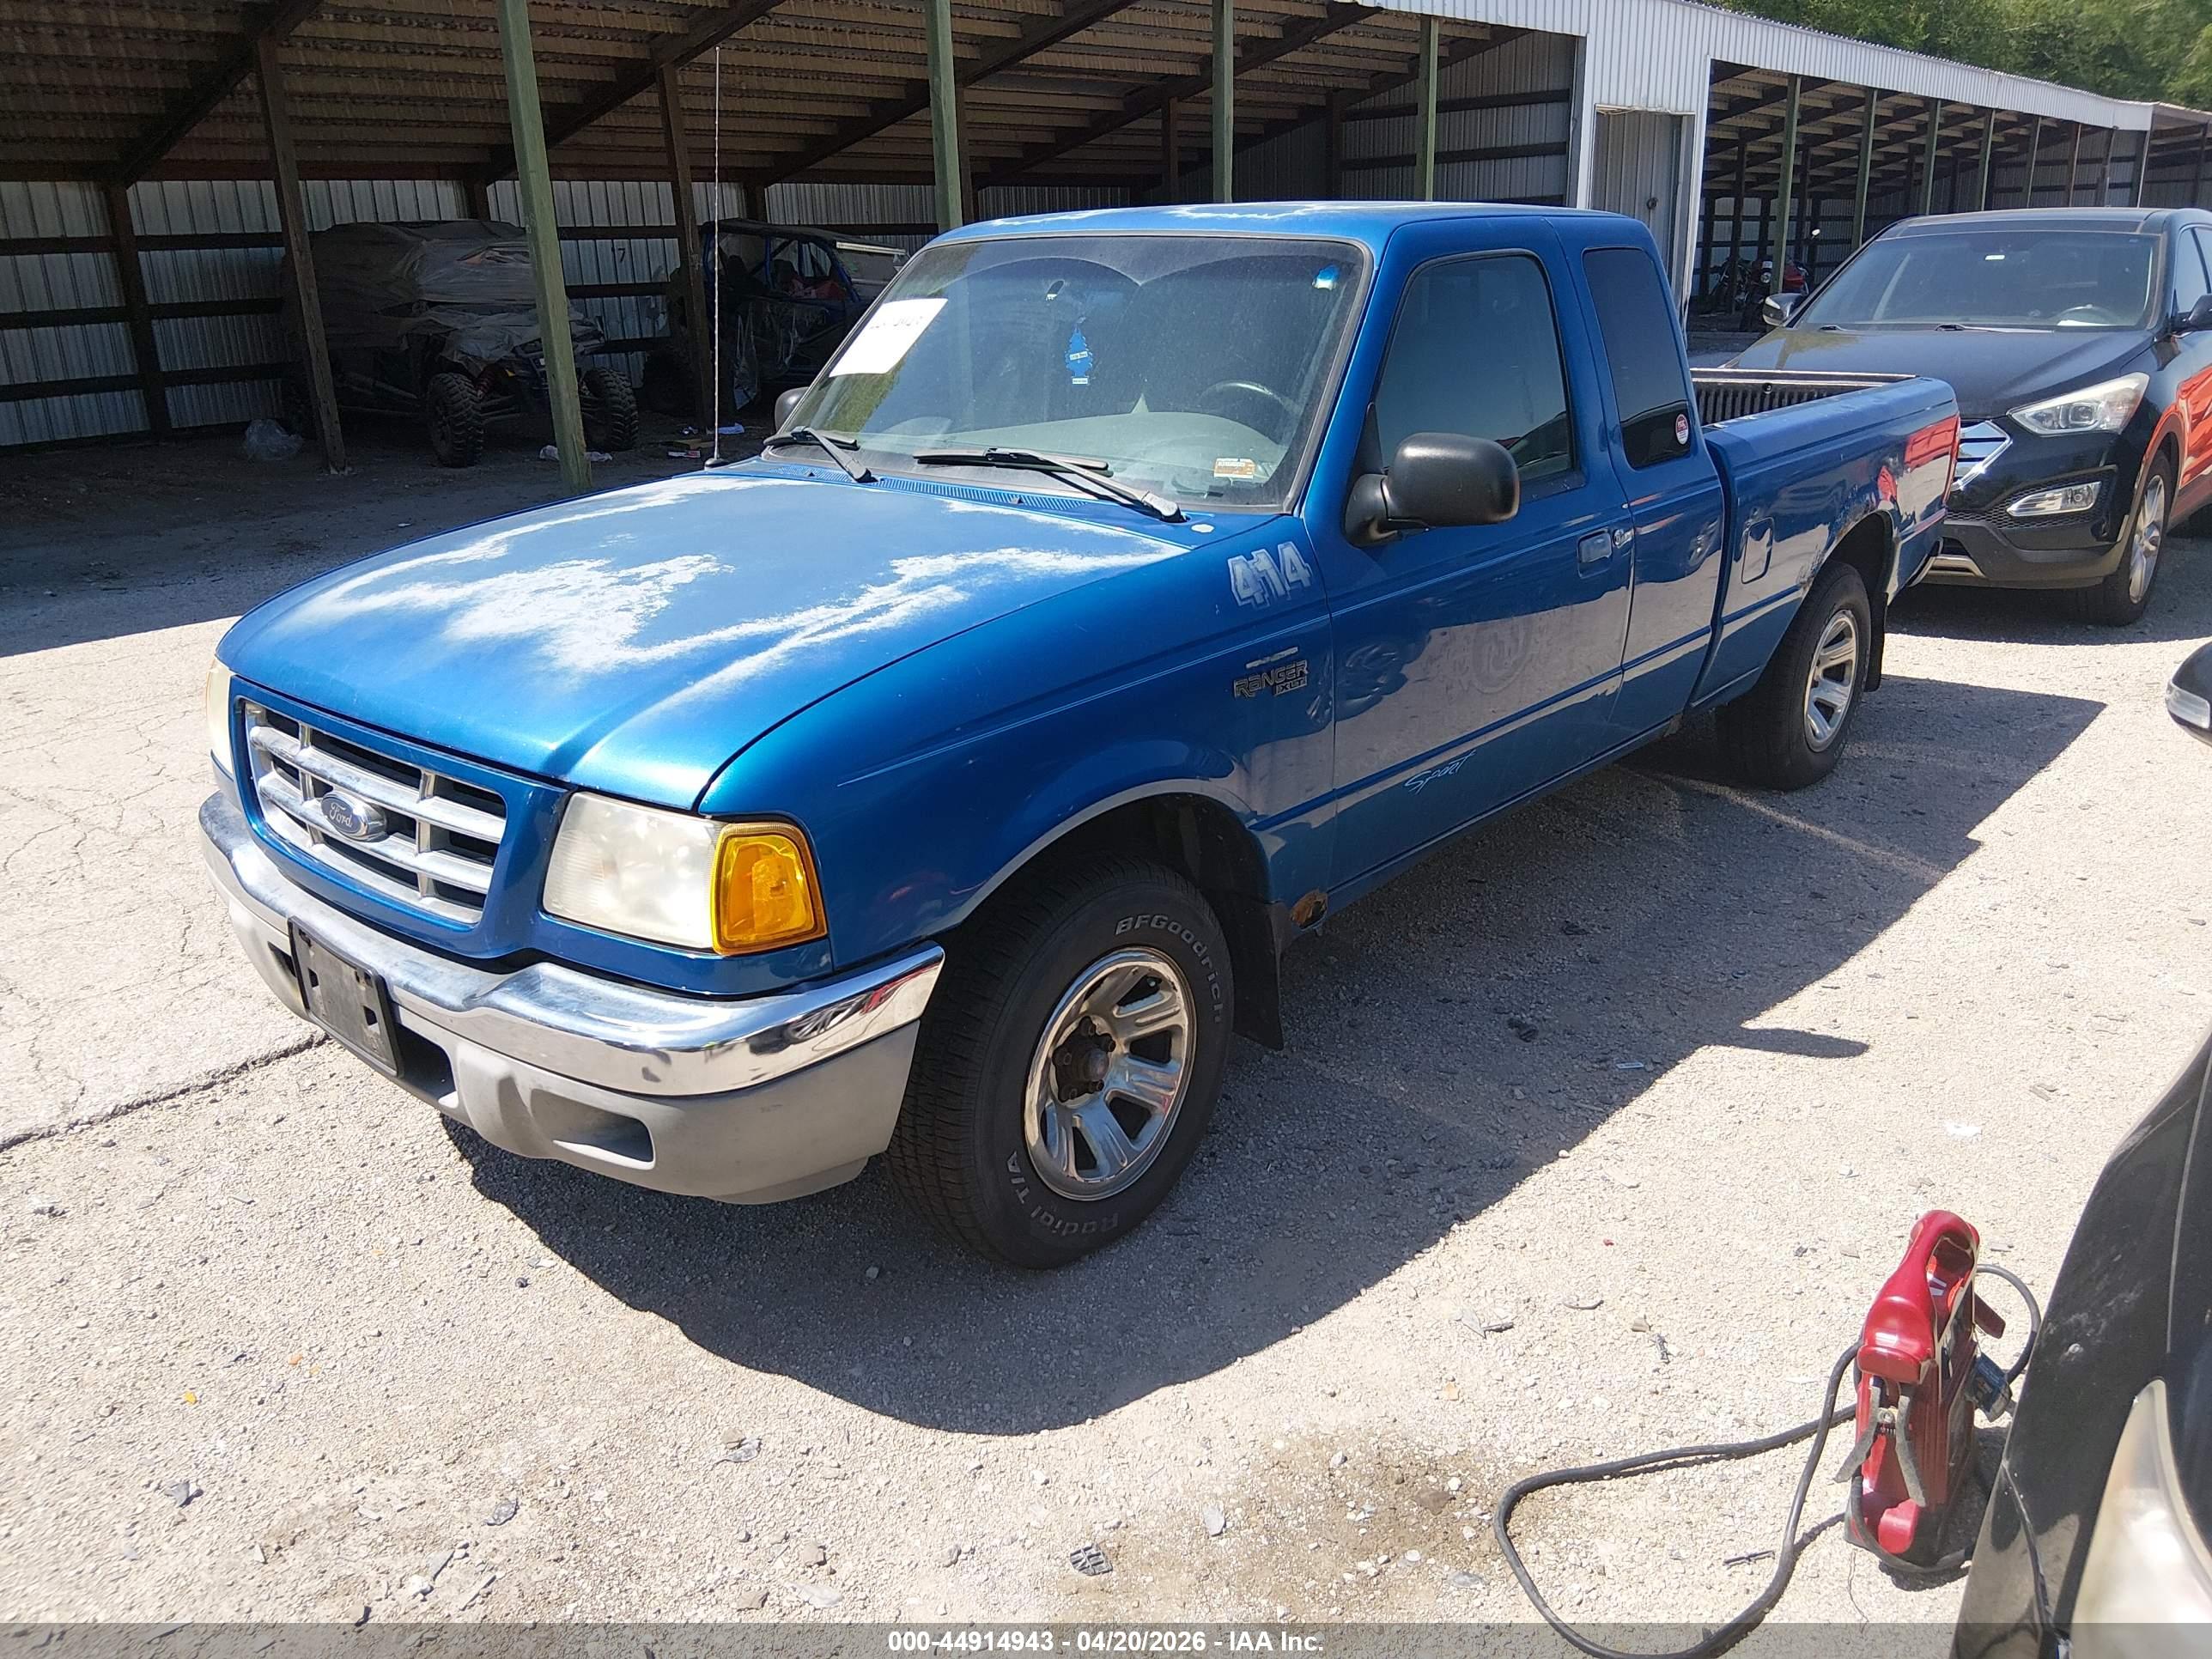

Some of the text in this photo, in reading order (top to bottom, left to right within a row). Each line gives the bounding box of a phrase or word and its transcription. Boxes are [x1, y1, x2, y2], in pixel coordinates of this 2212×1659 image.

[1227, 541, 1313, 609] 414
[1233, 659, 1309, 698] RANGER
[1276, 676, 1307, 696] XLT
[329, 801, 353, 828] Ford
